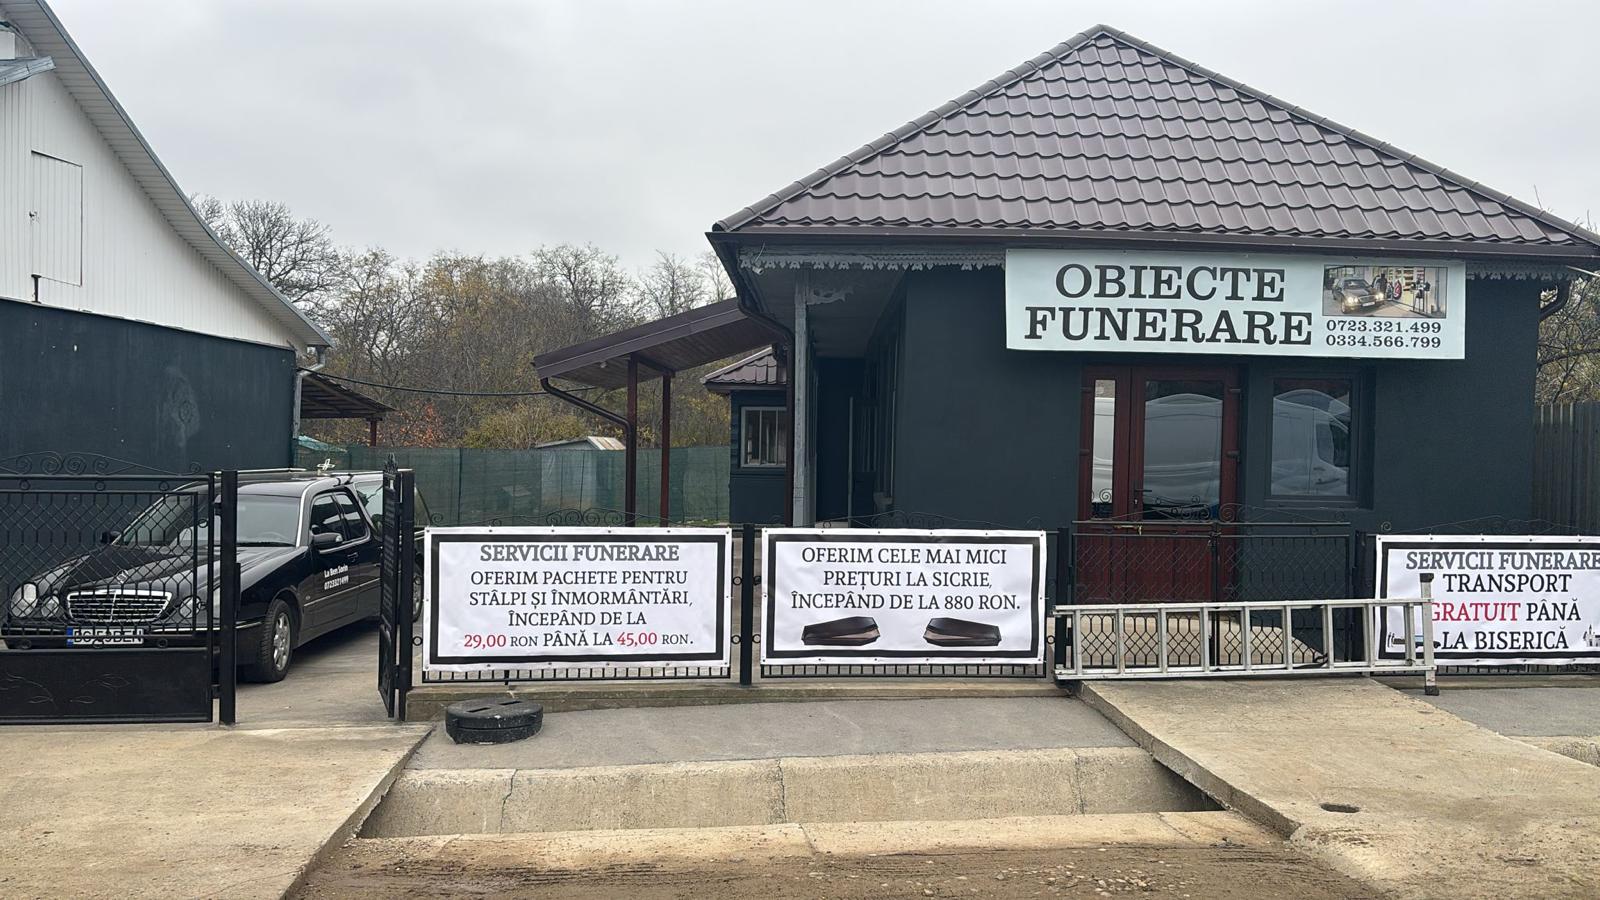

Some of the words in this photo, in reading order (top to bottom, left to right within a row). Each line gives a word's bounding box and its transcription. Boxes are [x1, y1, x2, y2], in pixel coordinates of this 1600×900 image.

[1055, 263, 1286, 303] OBIECTE
[1023, 306, 1313, 346] FUNERARE
[1326, 319, 1441, 333] 0723.321.499
[1326, 334, 1441, 348] 0334.566.799
[480, 544, 569, 562] SERVICII
[572, 544, 680, 562] FUNERARE
[802, 547, 873, 563] OFERIM
[878, 548, 921, 564] CELE
[926, 549, 961, 565] MAI
[966, 549, 1007, 565] MICI
[1405, 551, 1494, 570] SERVICII
[1499, 551, 1600, 570] FUNERARE
[470, 570, 538, 585] OFERIM
[542, 570, 618, 585] PACHETE
[621, 570, 688, 585] PENTRU
[823, 571, 901, 590] PREȚURI
[906, 571, 928, 587] LA
[932, 571, 993, 589] SICRIE,
[1442, 573, 1573, 593] TRANSPORT
[469, 589, 526, 606] STÂLPI
[530, 591, 548, 610] ȘI
[551, 589, 693, 608] ÎNMORMÂNTĂRI,
[791, 591, 885, 609] ÎNCEPÂND
[889, 594, 914, 610] DE
[917, 594, 941, 610] LA
[944, 594, 974, 610] 880
[978, 594, 1021, 611] RON.
[508, 610, 596, 627] ÎNCEPÂND
[600, 611, 623, 625] DE
[627, 611, 647, 625] LA
[1525, 598, 1582, 621] PÂNĂ
[464, 634, 507, 649] 29,00
[510, 636, 538, 647] RON
[543, 630, 588, 647] PÂNĂ
[593, 632, 614, 647] LA
[616, 632, 658, 647] 45,00
[661, 633, 694, 645] RON.
[1441, 631, 1469, 650] LA
[1474, 626, 1570, 650] BISERICĂ
